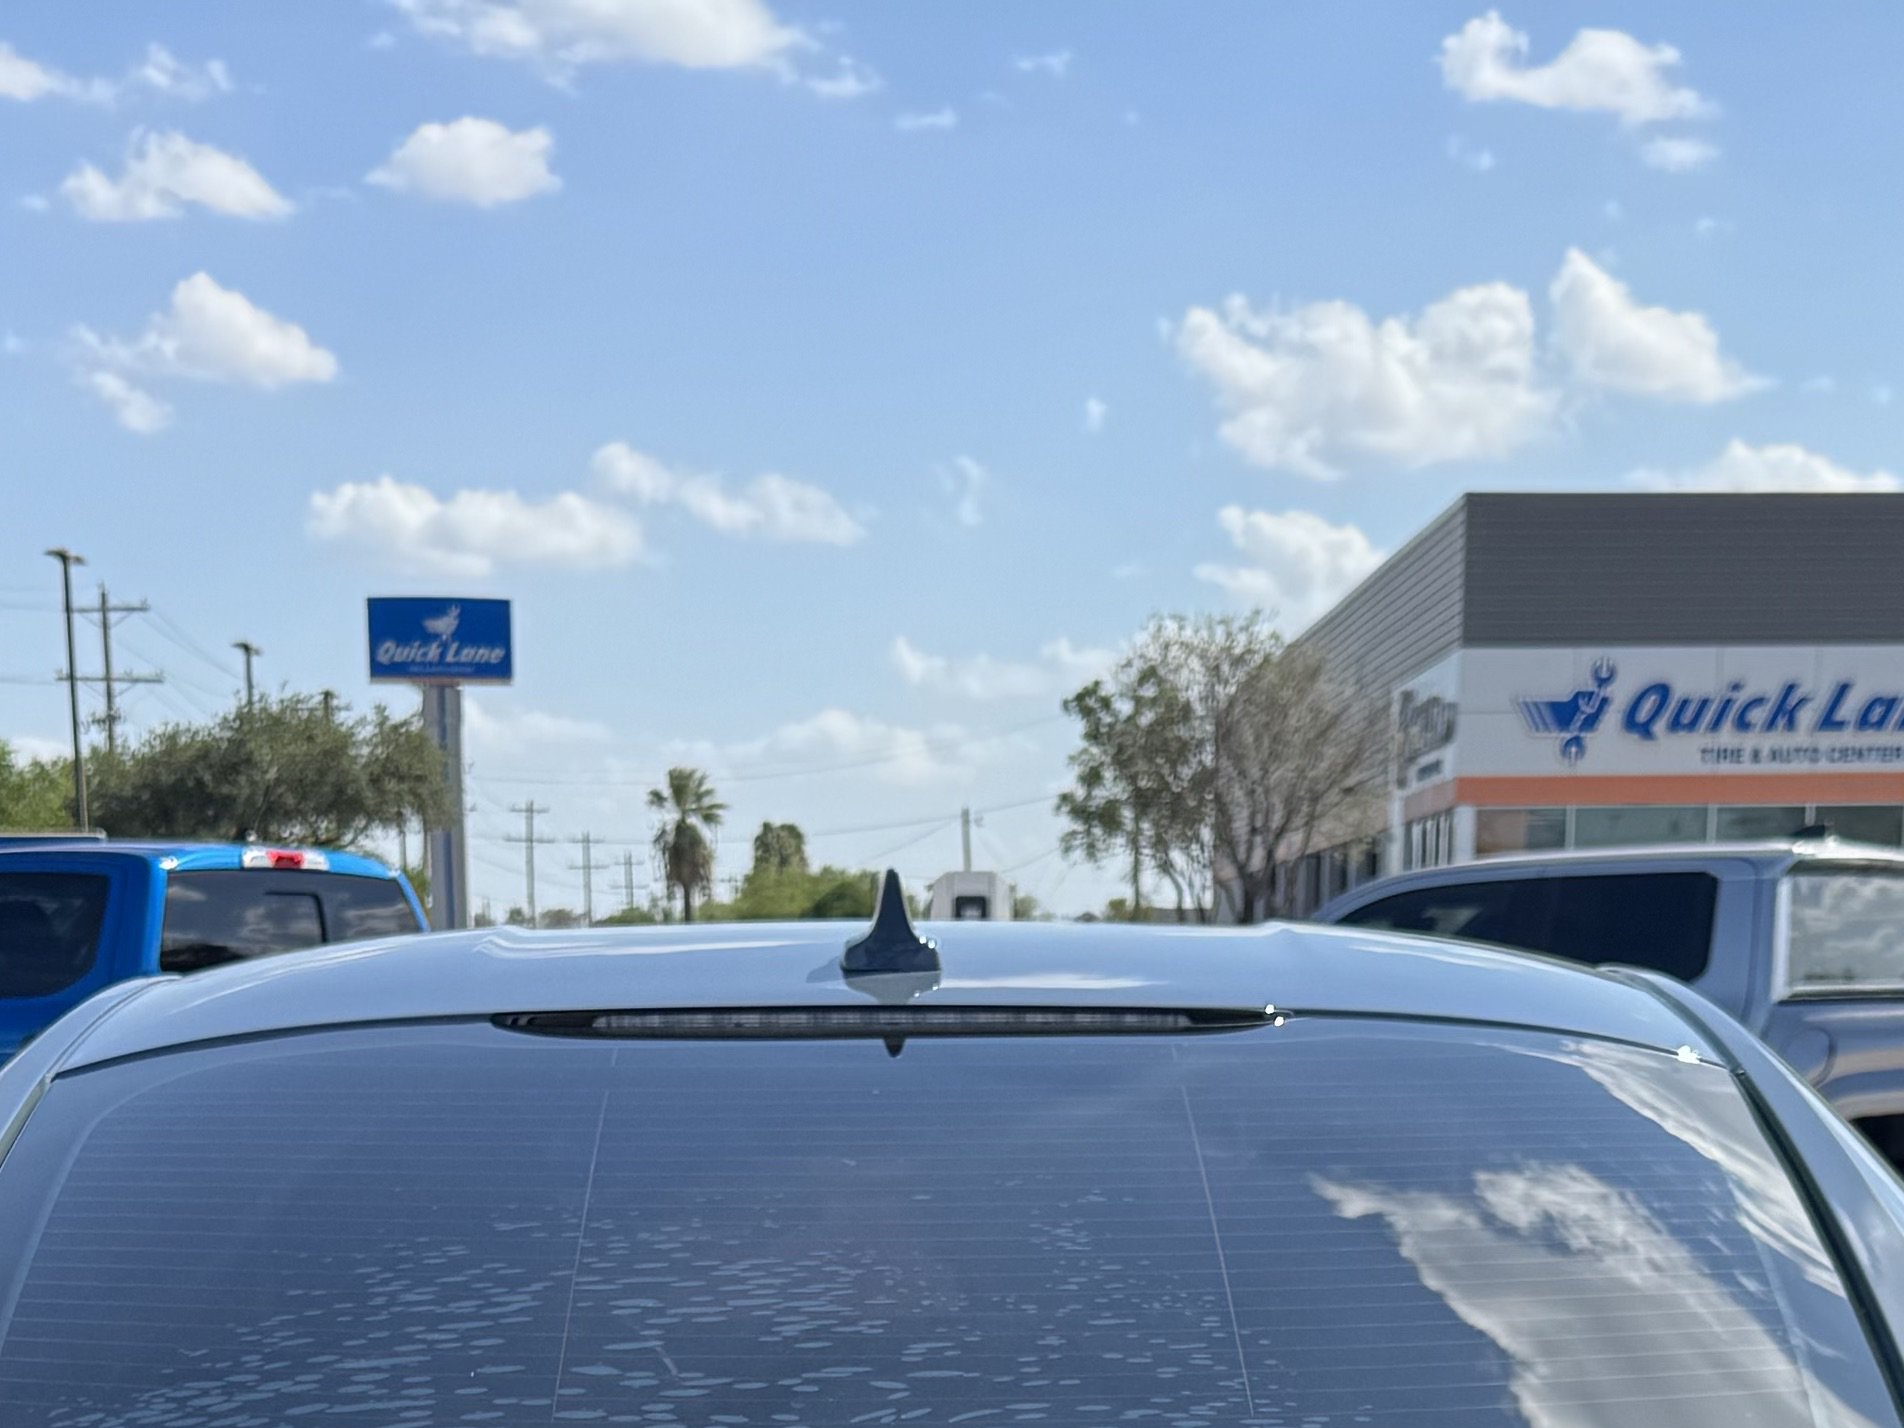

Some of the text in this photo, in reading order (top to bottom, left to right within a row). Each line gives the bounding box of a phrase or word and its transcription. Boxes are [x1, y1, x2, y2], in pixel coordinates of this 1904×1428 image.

[377, 640, 506, 666] Quick Lane
[1619, 679, 1810, 741] Quick
